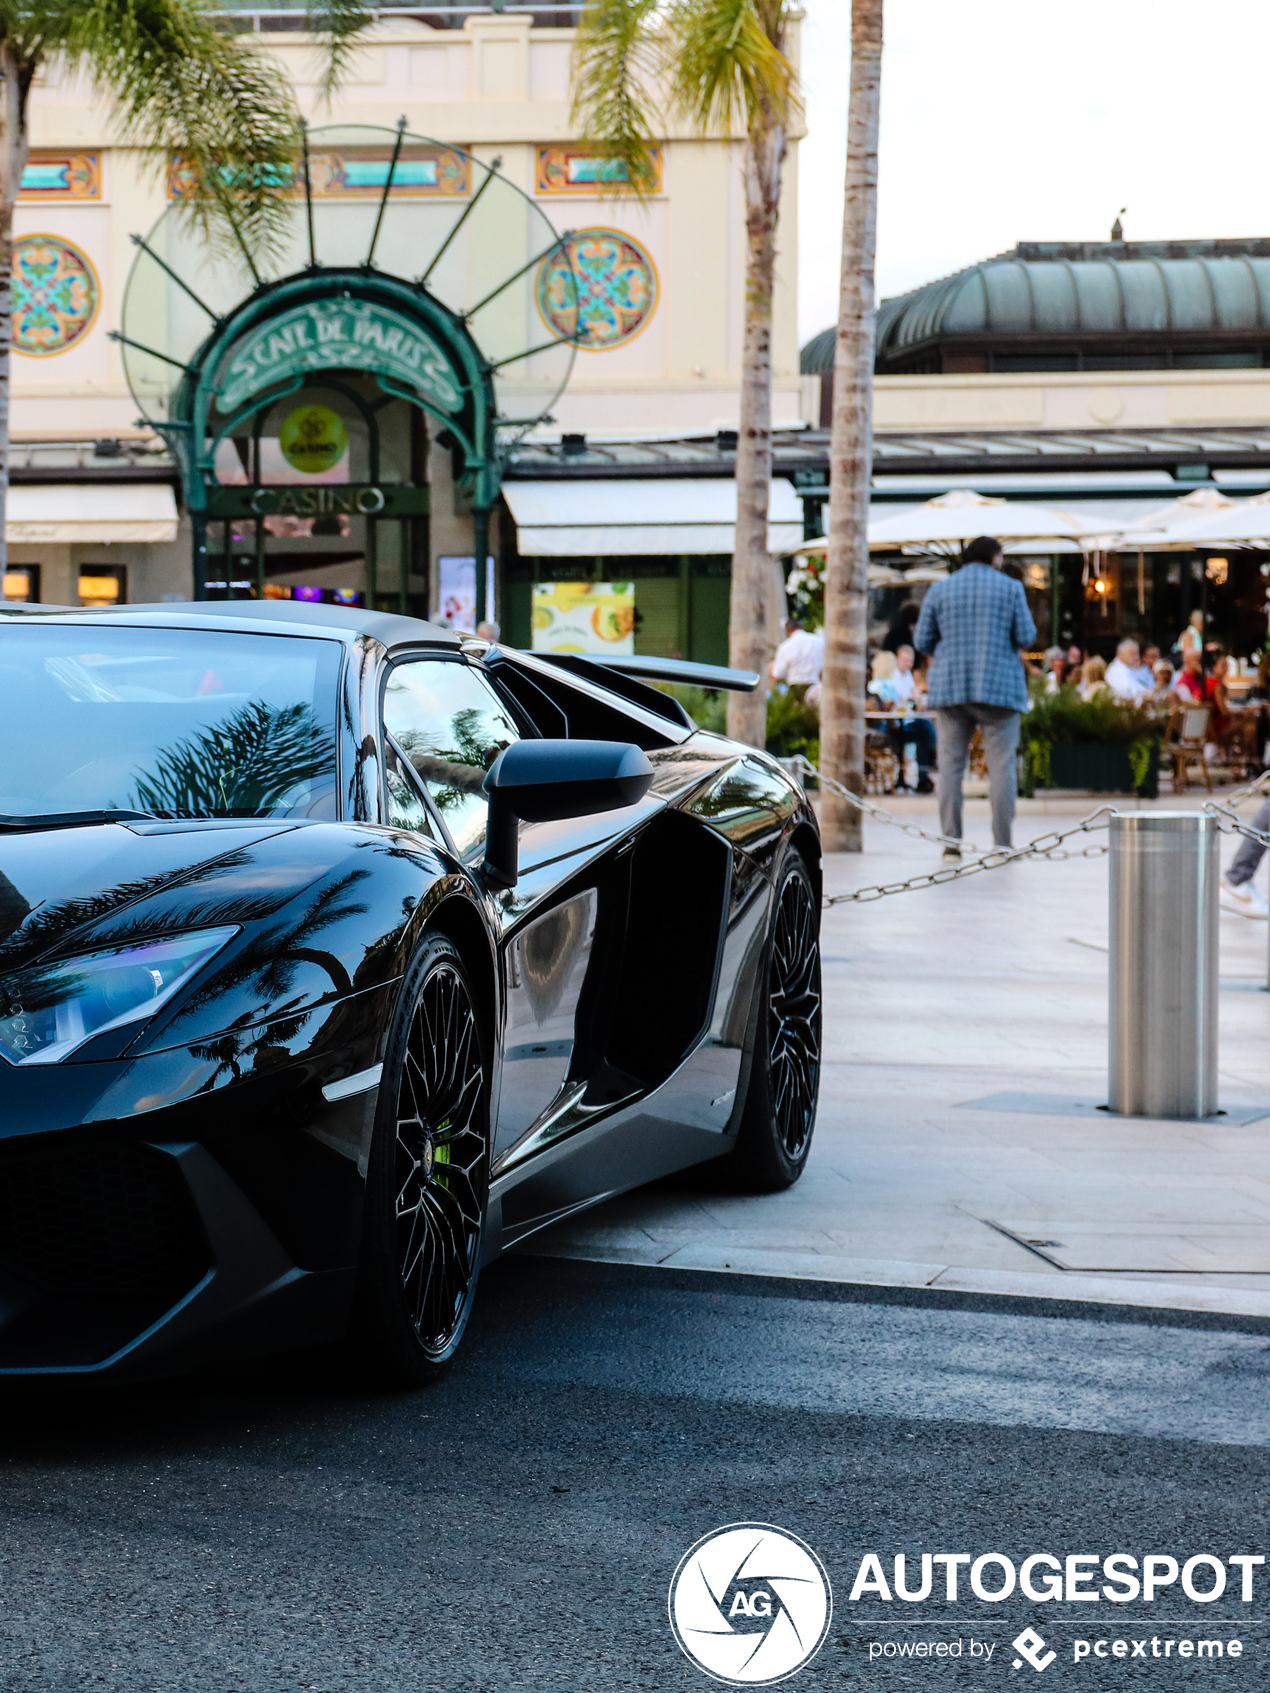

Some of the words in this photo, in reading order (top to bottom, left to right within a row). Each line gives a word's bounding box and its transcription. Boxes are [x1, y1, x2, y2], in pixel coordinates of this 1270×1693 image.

[316, 316, 346, 342] DE
[353, 318, 425, 369] PARIS
[251, 486, 385, 514] CASINO
